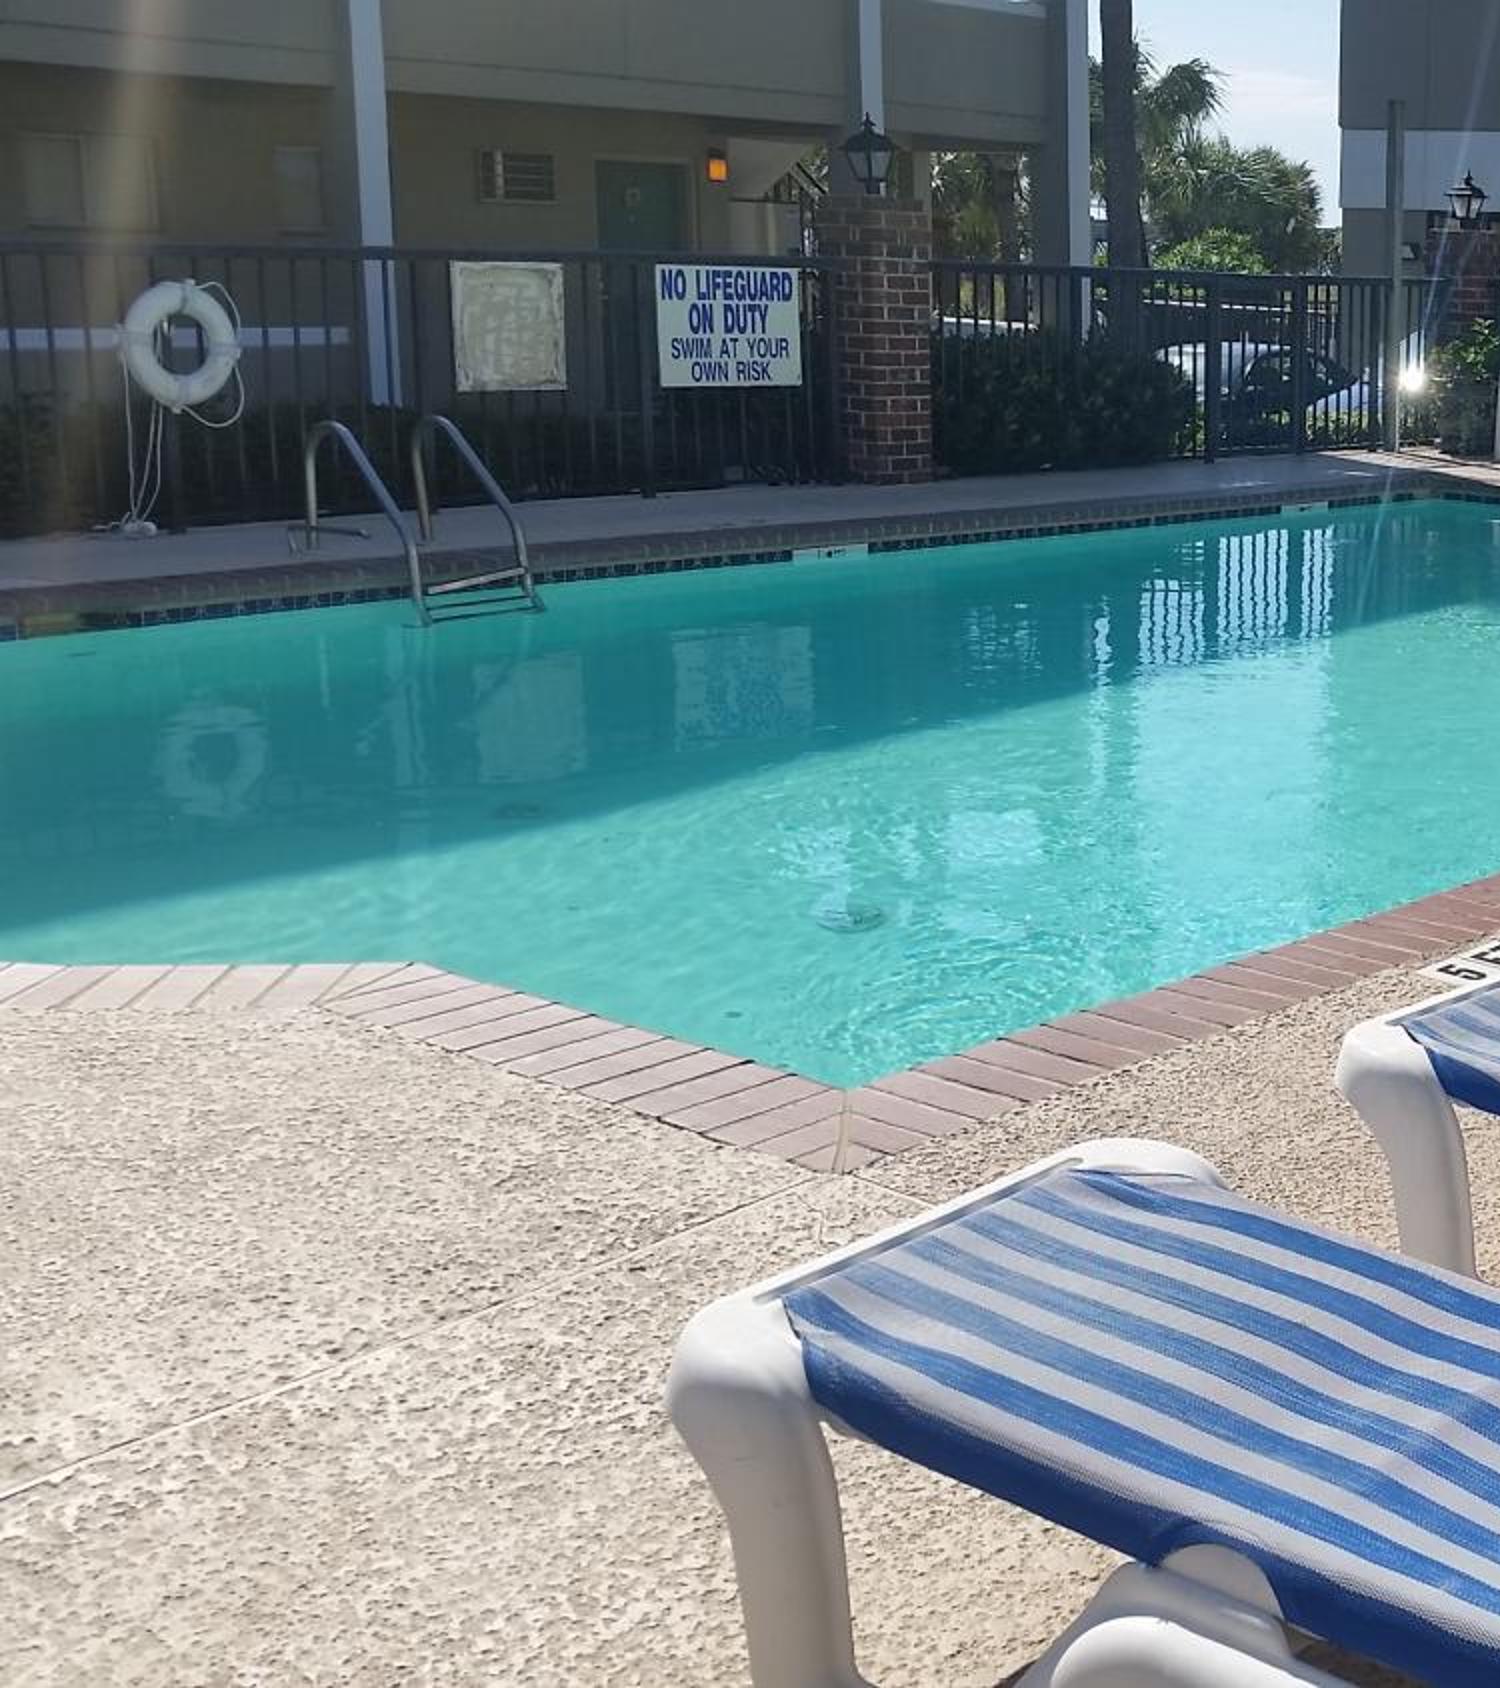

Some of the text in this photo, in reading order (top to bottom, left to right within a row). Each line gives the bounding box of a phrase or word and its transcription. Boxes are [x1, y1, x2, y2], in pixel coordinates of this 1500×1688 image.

[661, 268, 793, 301] NO LIFEGUARD
[688, 303, 769, 334] ON DUTY
[671, 337, 789, 360] SWIM AT YOUR
[691, 361, 772, 382] OWN RISK
[1437, 963, 1487, 981] 5
